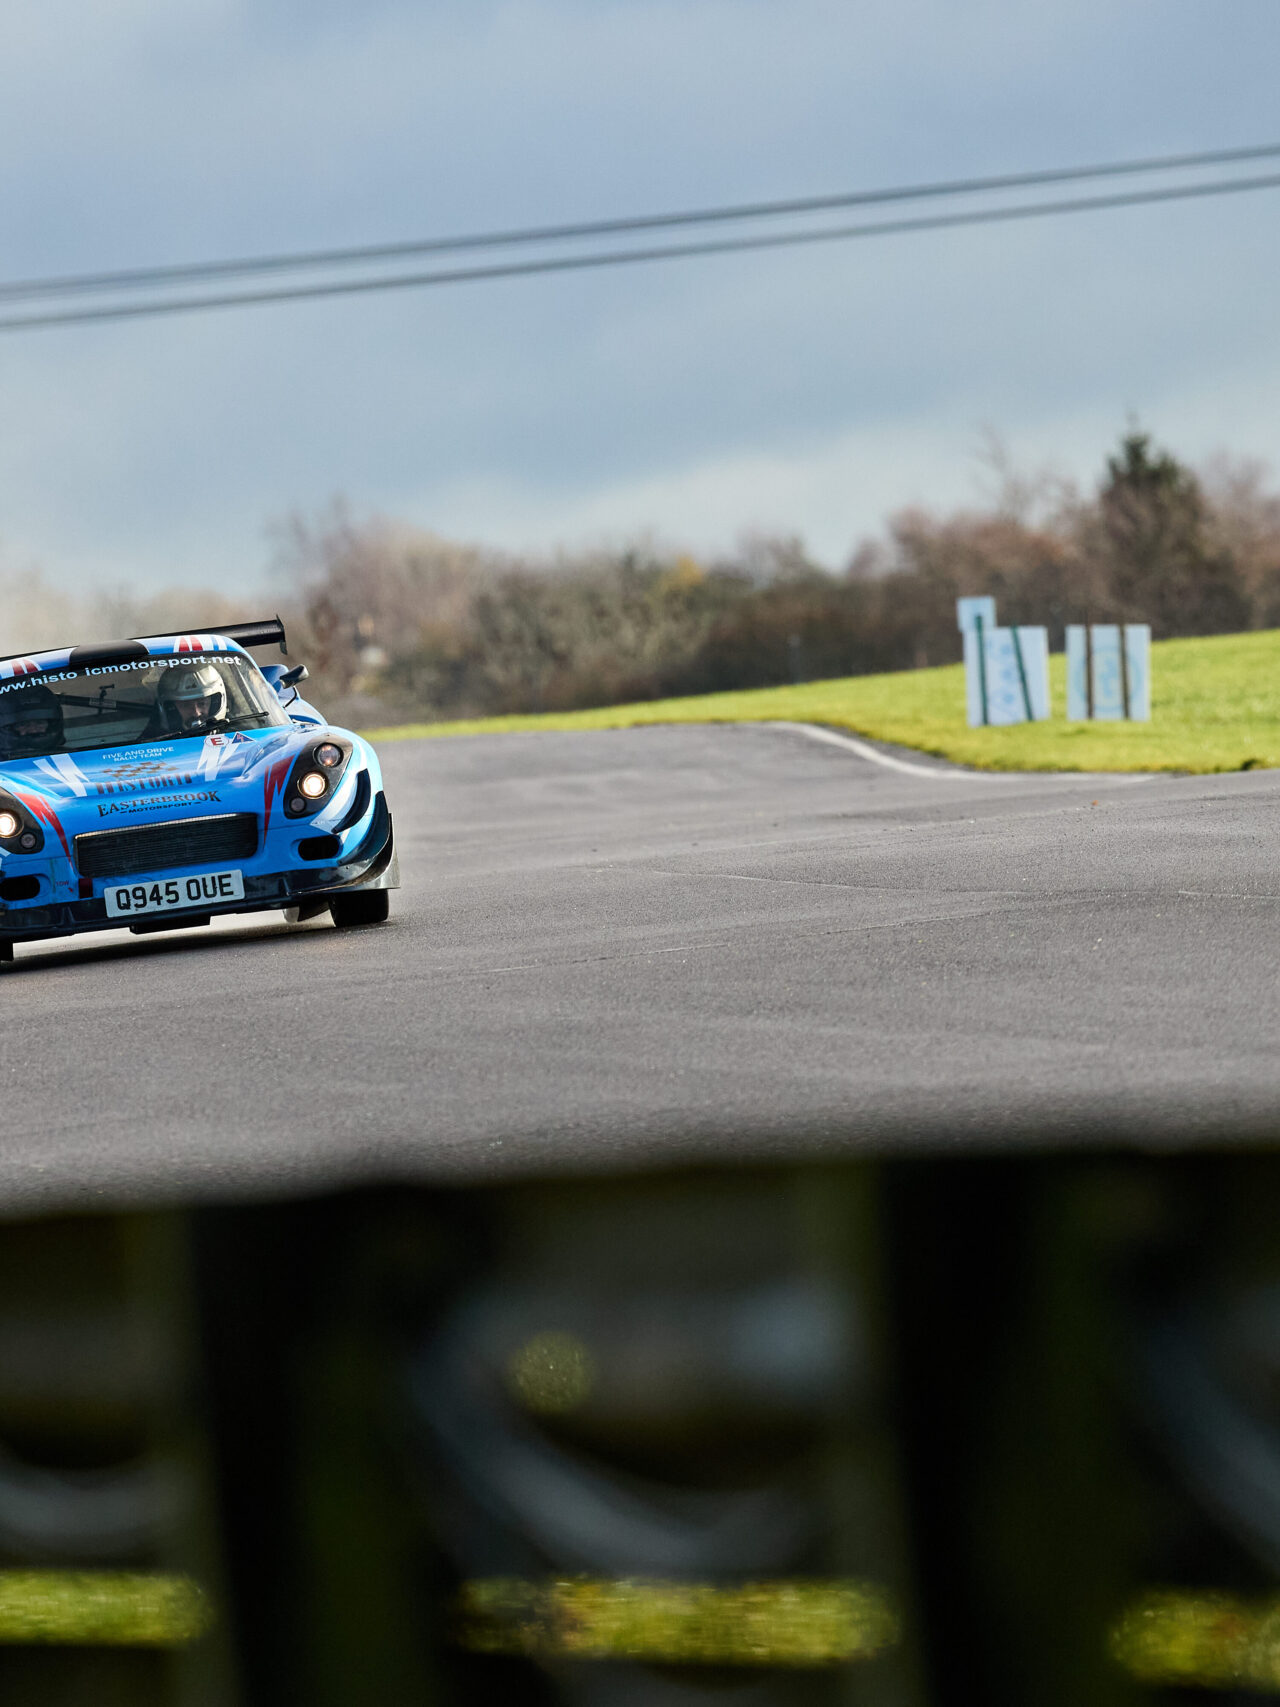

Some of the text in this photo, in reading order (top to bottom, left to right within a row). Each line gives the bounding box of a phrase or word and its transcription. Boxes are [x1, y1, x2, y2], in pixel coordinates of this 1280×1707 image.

[210, 737, 224, 746] E
[102, 746, 175, 760] FIVE AND DRIVE
[113, 754, 138, 762] RALLY
[97, 790, 222, 817] EASTERBROOK
[128, 802, 193, 813] MOTORSPORT
[116, 873, 234, 911] Q945 OUE
